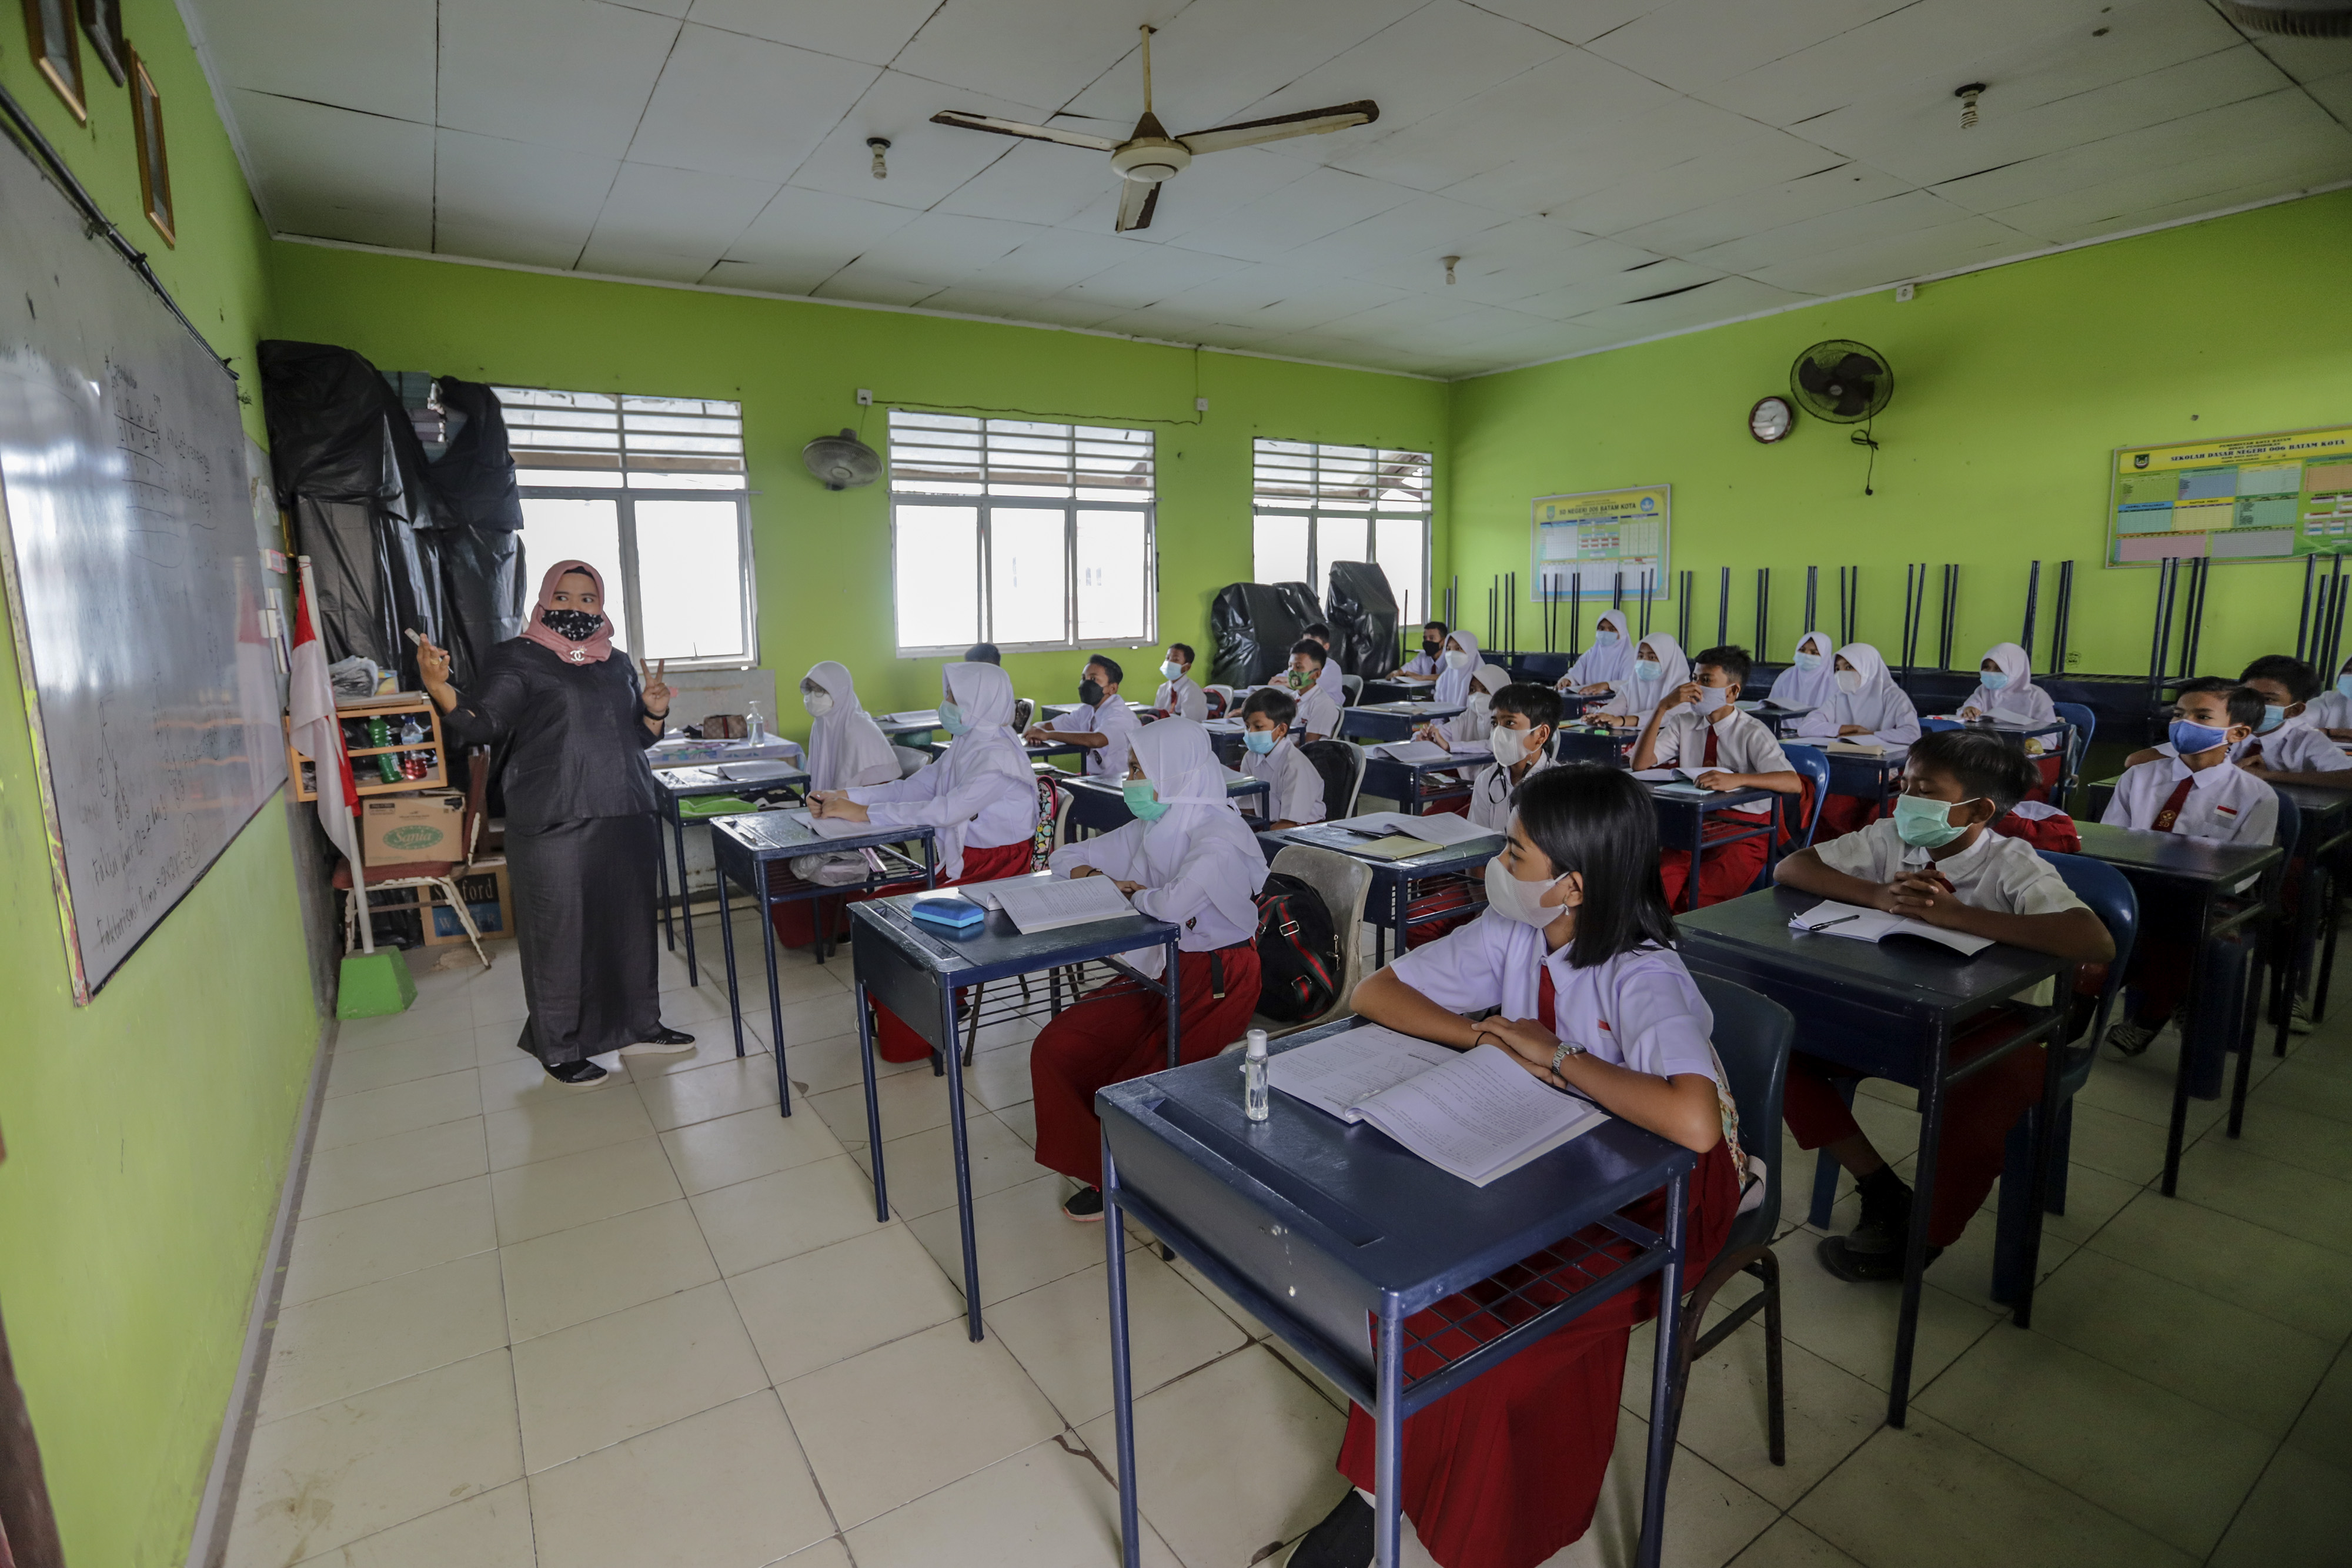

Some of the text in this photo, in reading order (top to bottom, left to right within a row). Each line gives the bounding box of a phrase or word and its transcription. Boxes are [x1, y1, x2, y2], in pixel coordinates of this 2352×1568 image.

[394, 829, 433, 844] Sania
[434, 878, 493, 902] Sford
[96, 901, 138, 954] Faktorisasi
[139, 886, 157, 918] Prima
